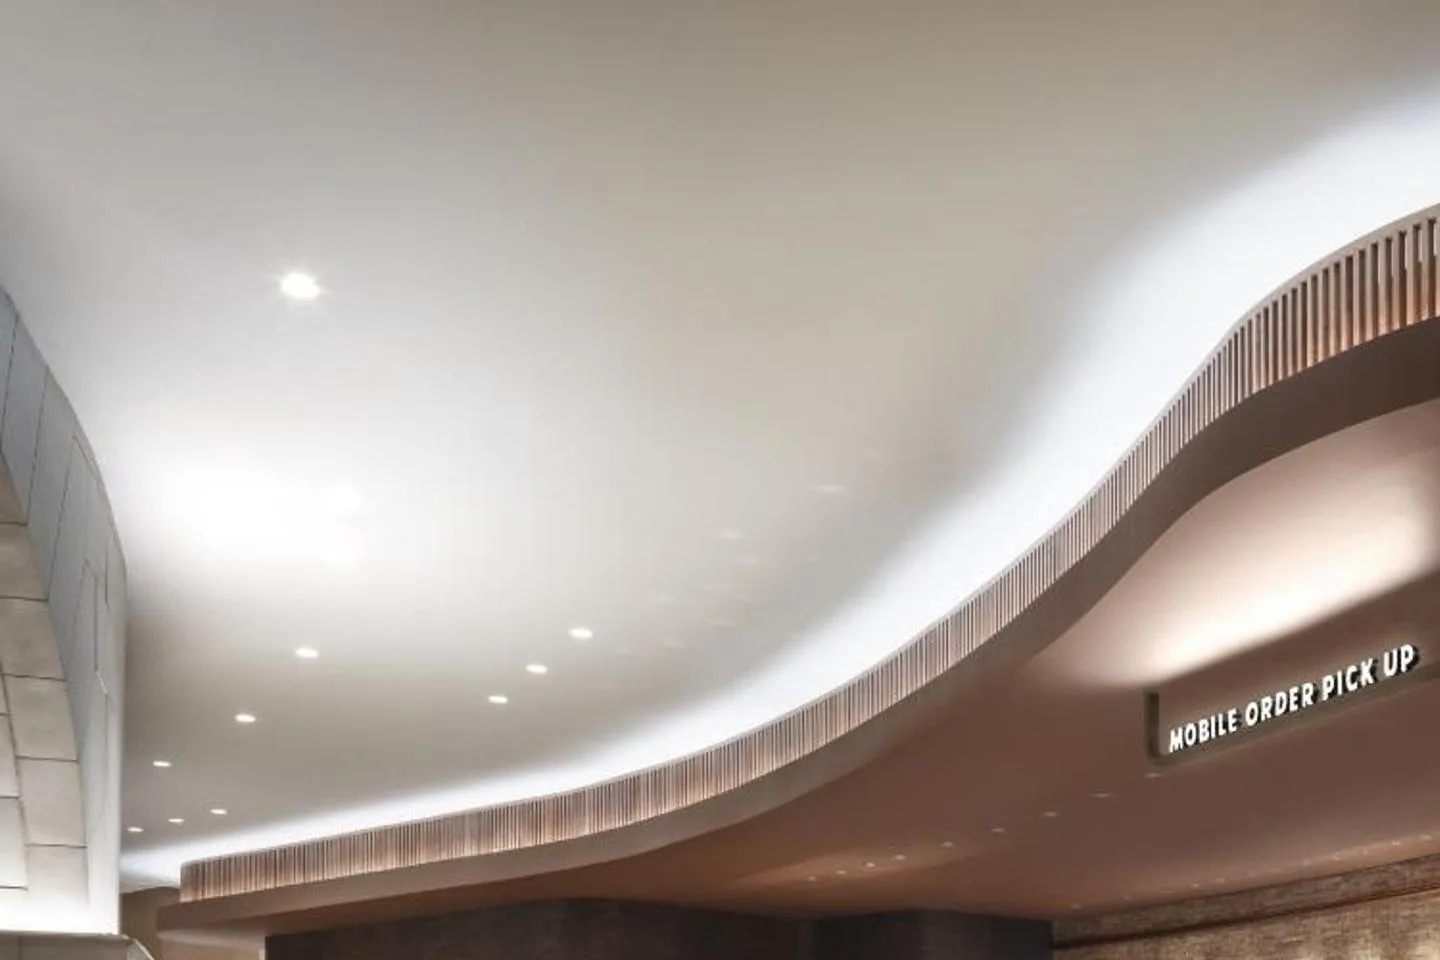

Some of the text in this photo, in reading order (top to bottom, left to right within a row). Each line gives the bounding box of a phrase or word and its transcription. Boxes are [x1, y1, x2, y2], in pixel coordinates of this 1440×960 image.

[1168, 644, 1415, 752] MOBILE ORDER PICK UP
